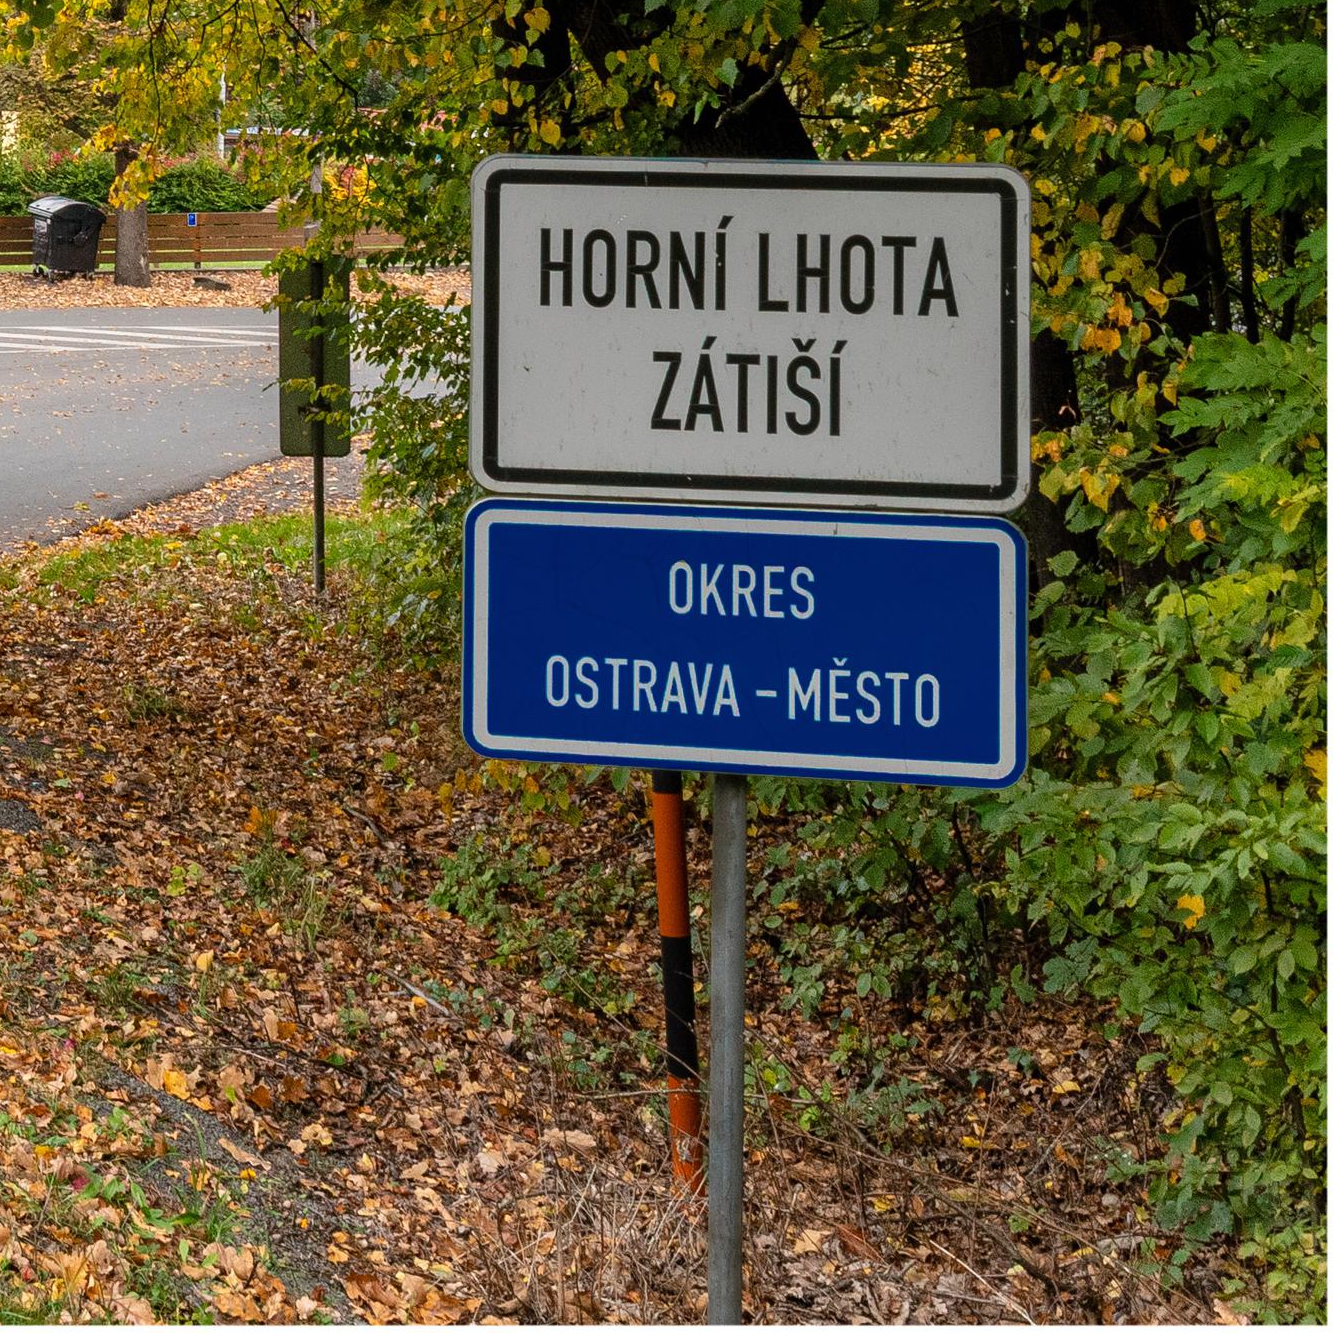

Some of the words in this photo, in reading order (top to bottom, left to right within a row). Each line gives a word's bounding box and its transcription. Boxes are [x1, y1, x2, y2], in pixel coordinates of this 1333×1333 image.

[539, 215, 734, 311] HORNÍ
[758, 233, 959, 317] LHOTA
[650, 335, 848, 436] ZÁTIŠÍ
[668, 559, 815, 620] OKRES
[544, 655, 741, 718] OSTRAVA
